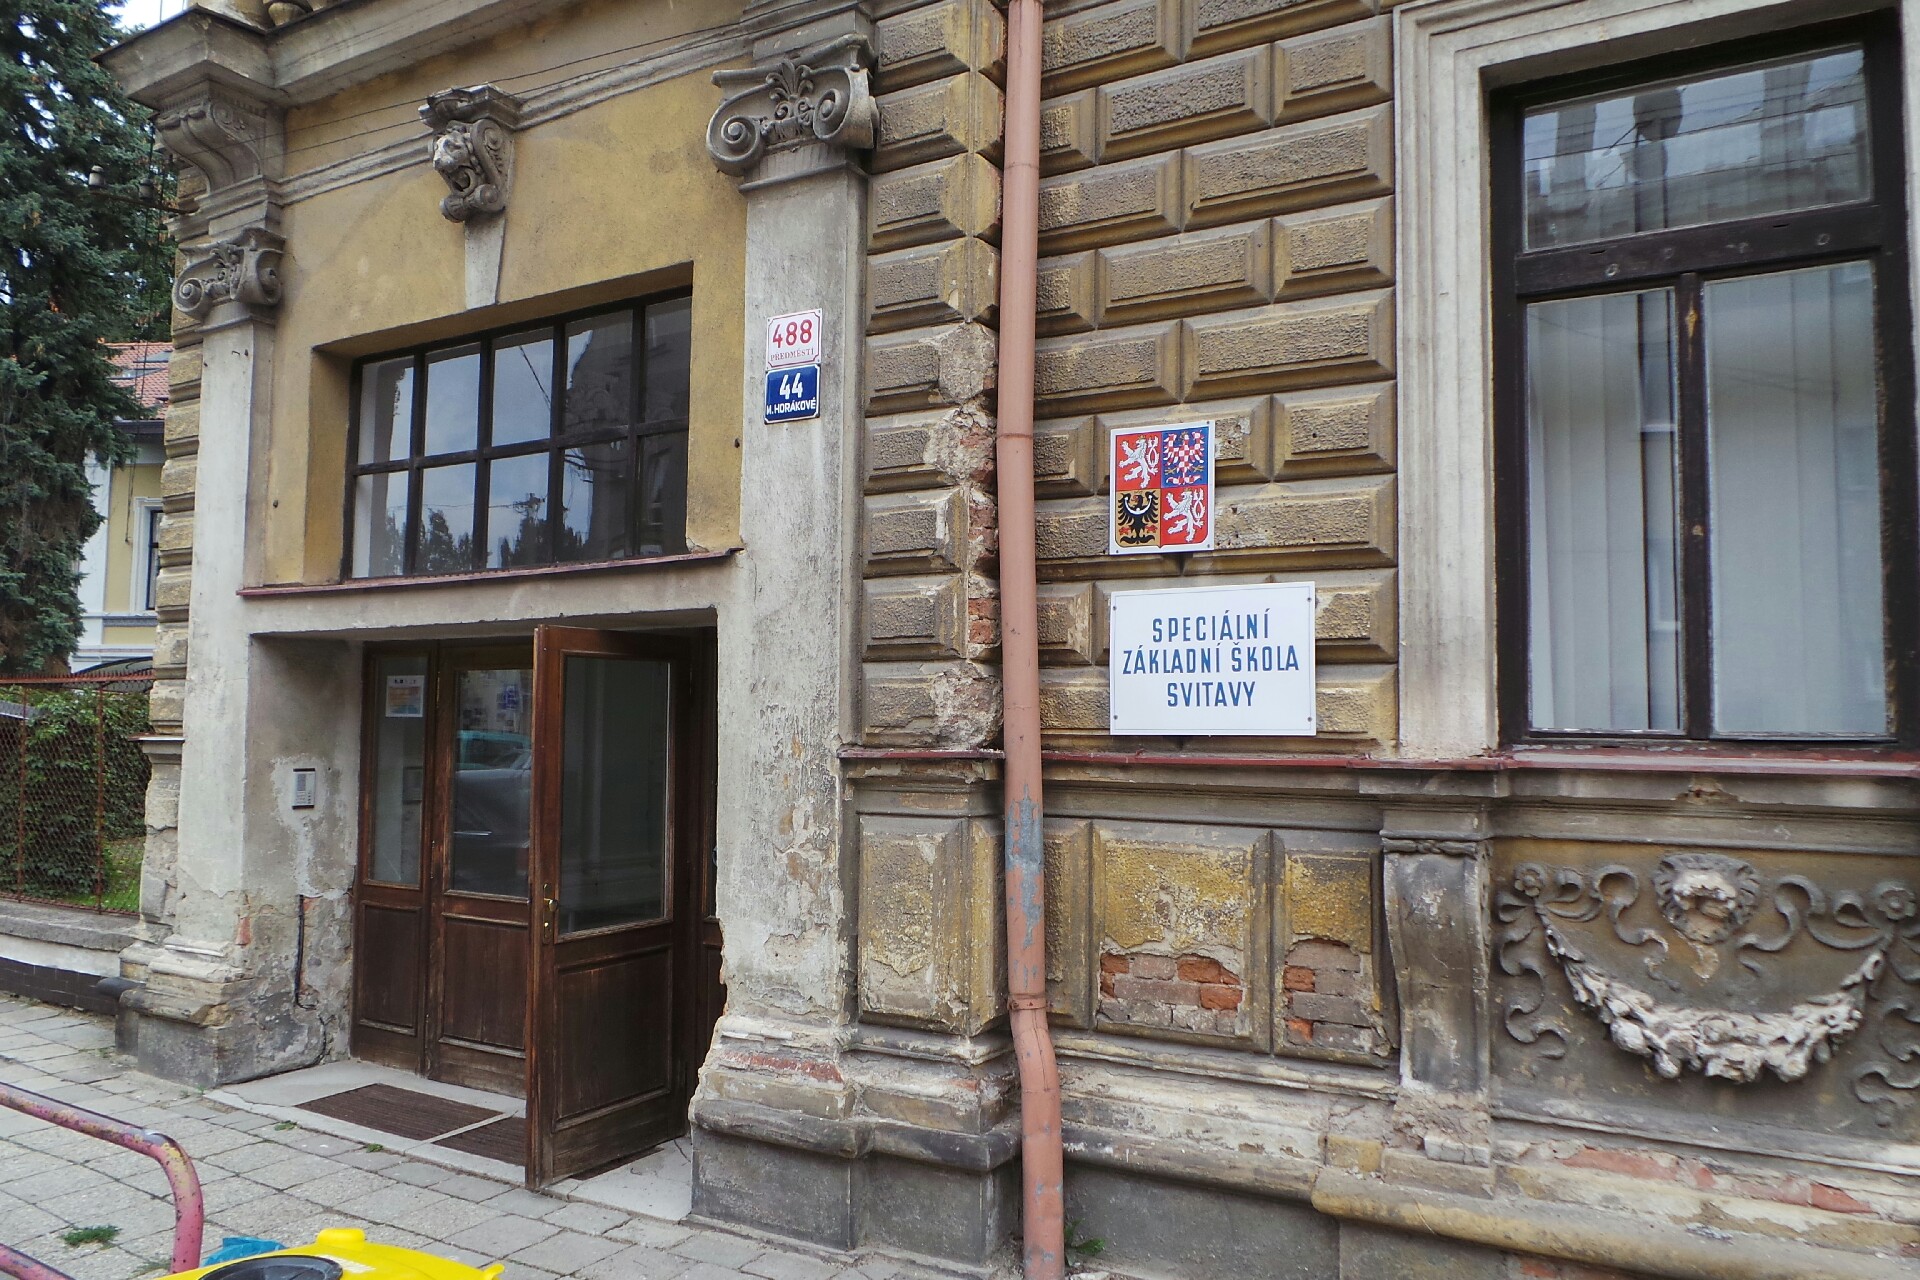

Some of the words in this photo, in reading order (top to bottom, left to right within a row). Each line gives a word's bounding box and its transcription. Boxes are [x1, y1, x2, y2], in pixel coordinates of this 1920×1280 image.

[772, 319, 813, 349] 488
[779, 372, 803, 400] 44
[1152, 608, 1270, 643] SPECIÁLNÍ
[1122, 642, 1221, 675] ZÁKLADNÍ
[1231, 642, 1300, 673] ŠKOLA
[1167, 681, 1256, 707] SVITAVY
